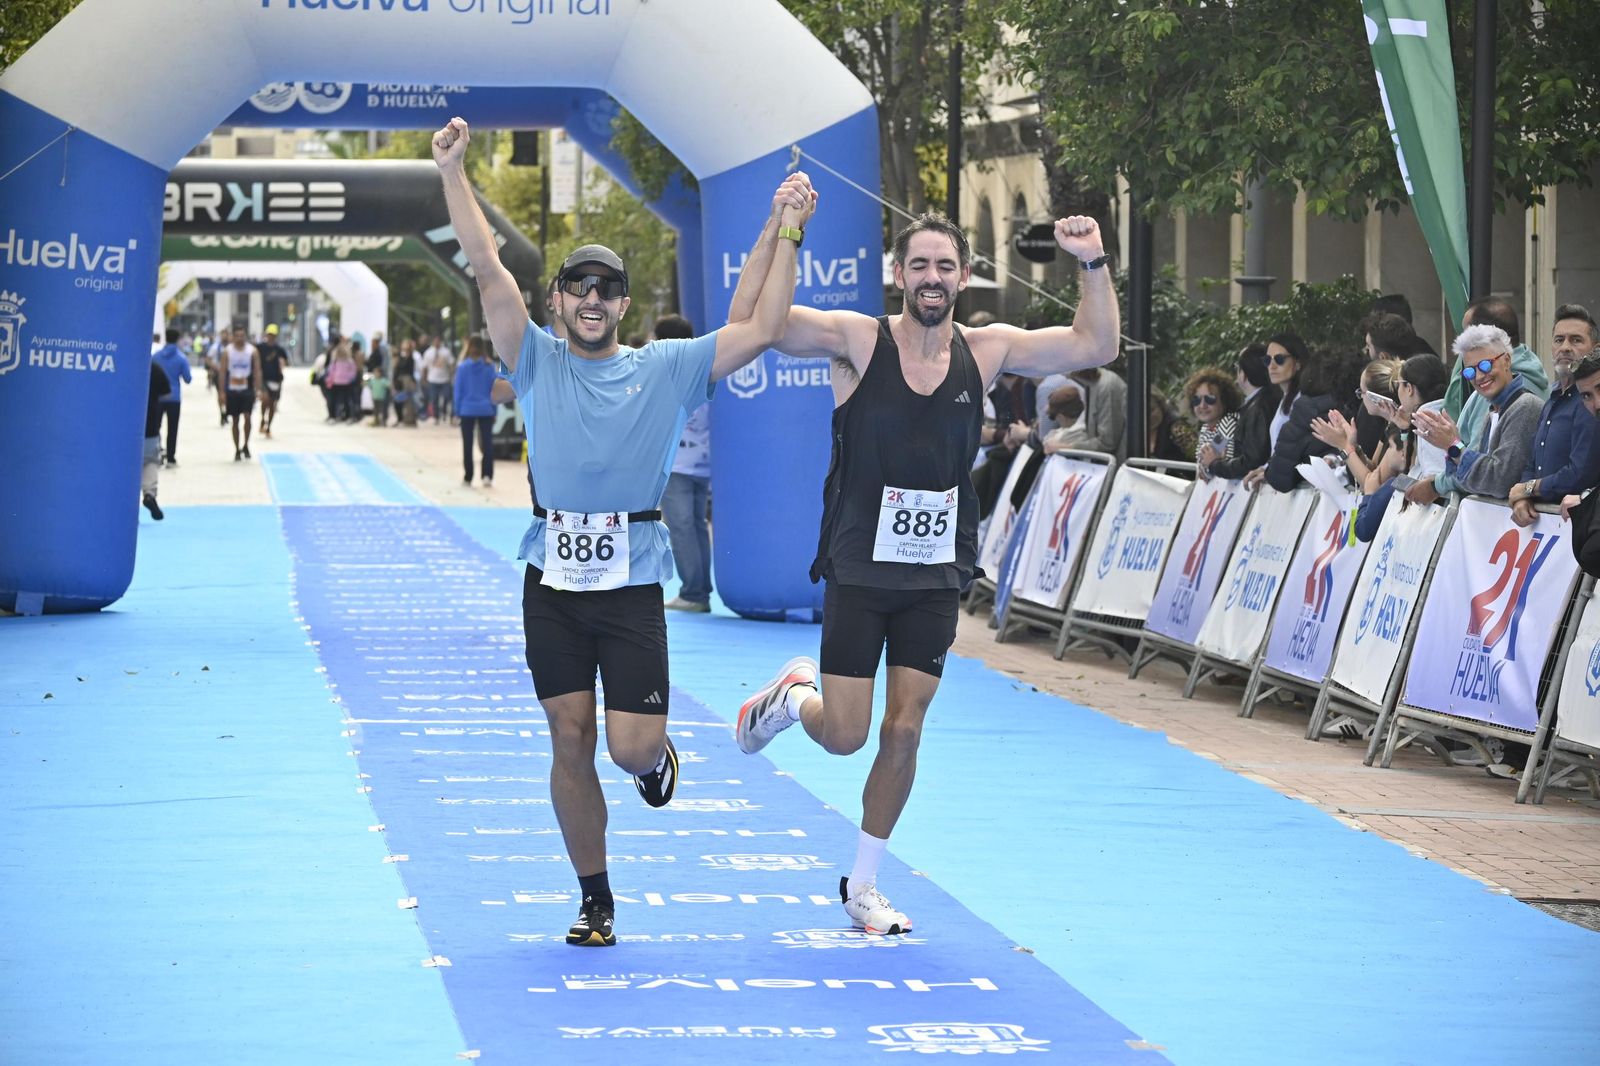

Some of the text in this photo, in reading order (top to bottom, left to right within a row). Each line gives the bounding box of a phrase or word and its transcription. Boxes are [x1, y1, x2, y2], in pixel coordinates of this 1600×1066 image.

[383, 94, 448, 107] HUELVA
[723, 248, 858, 288] Hlva
[74, 277, 124, 293] original
[813, 290, 859, 306] original
[31, 336, 118, 351] Ayuntamiento de
[29, 349, 116, 373] HUELVA
[776, 368, 831, 387] HUEL
[892, 510, 949, 537] 885
[557, 533, 614, 562] 886
[896, 547, 933, 558] Huelva
[1117, 536, 1165, 572] HUELVA
[564, 573, 600, 584] Huelva
[1450, 650, 1507, 704] HUELVA
[560, 977, 999, 992] Huelva
